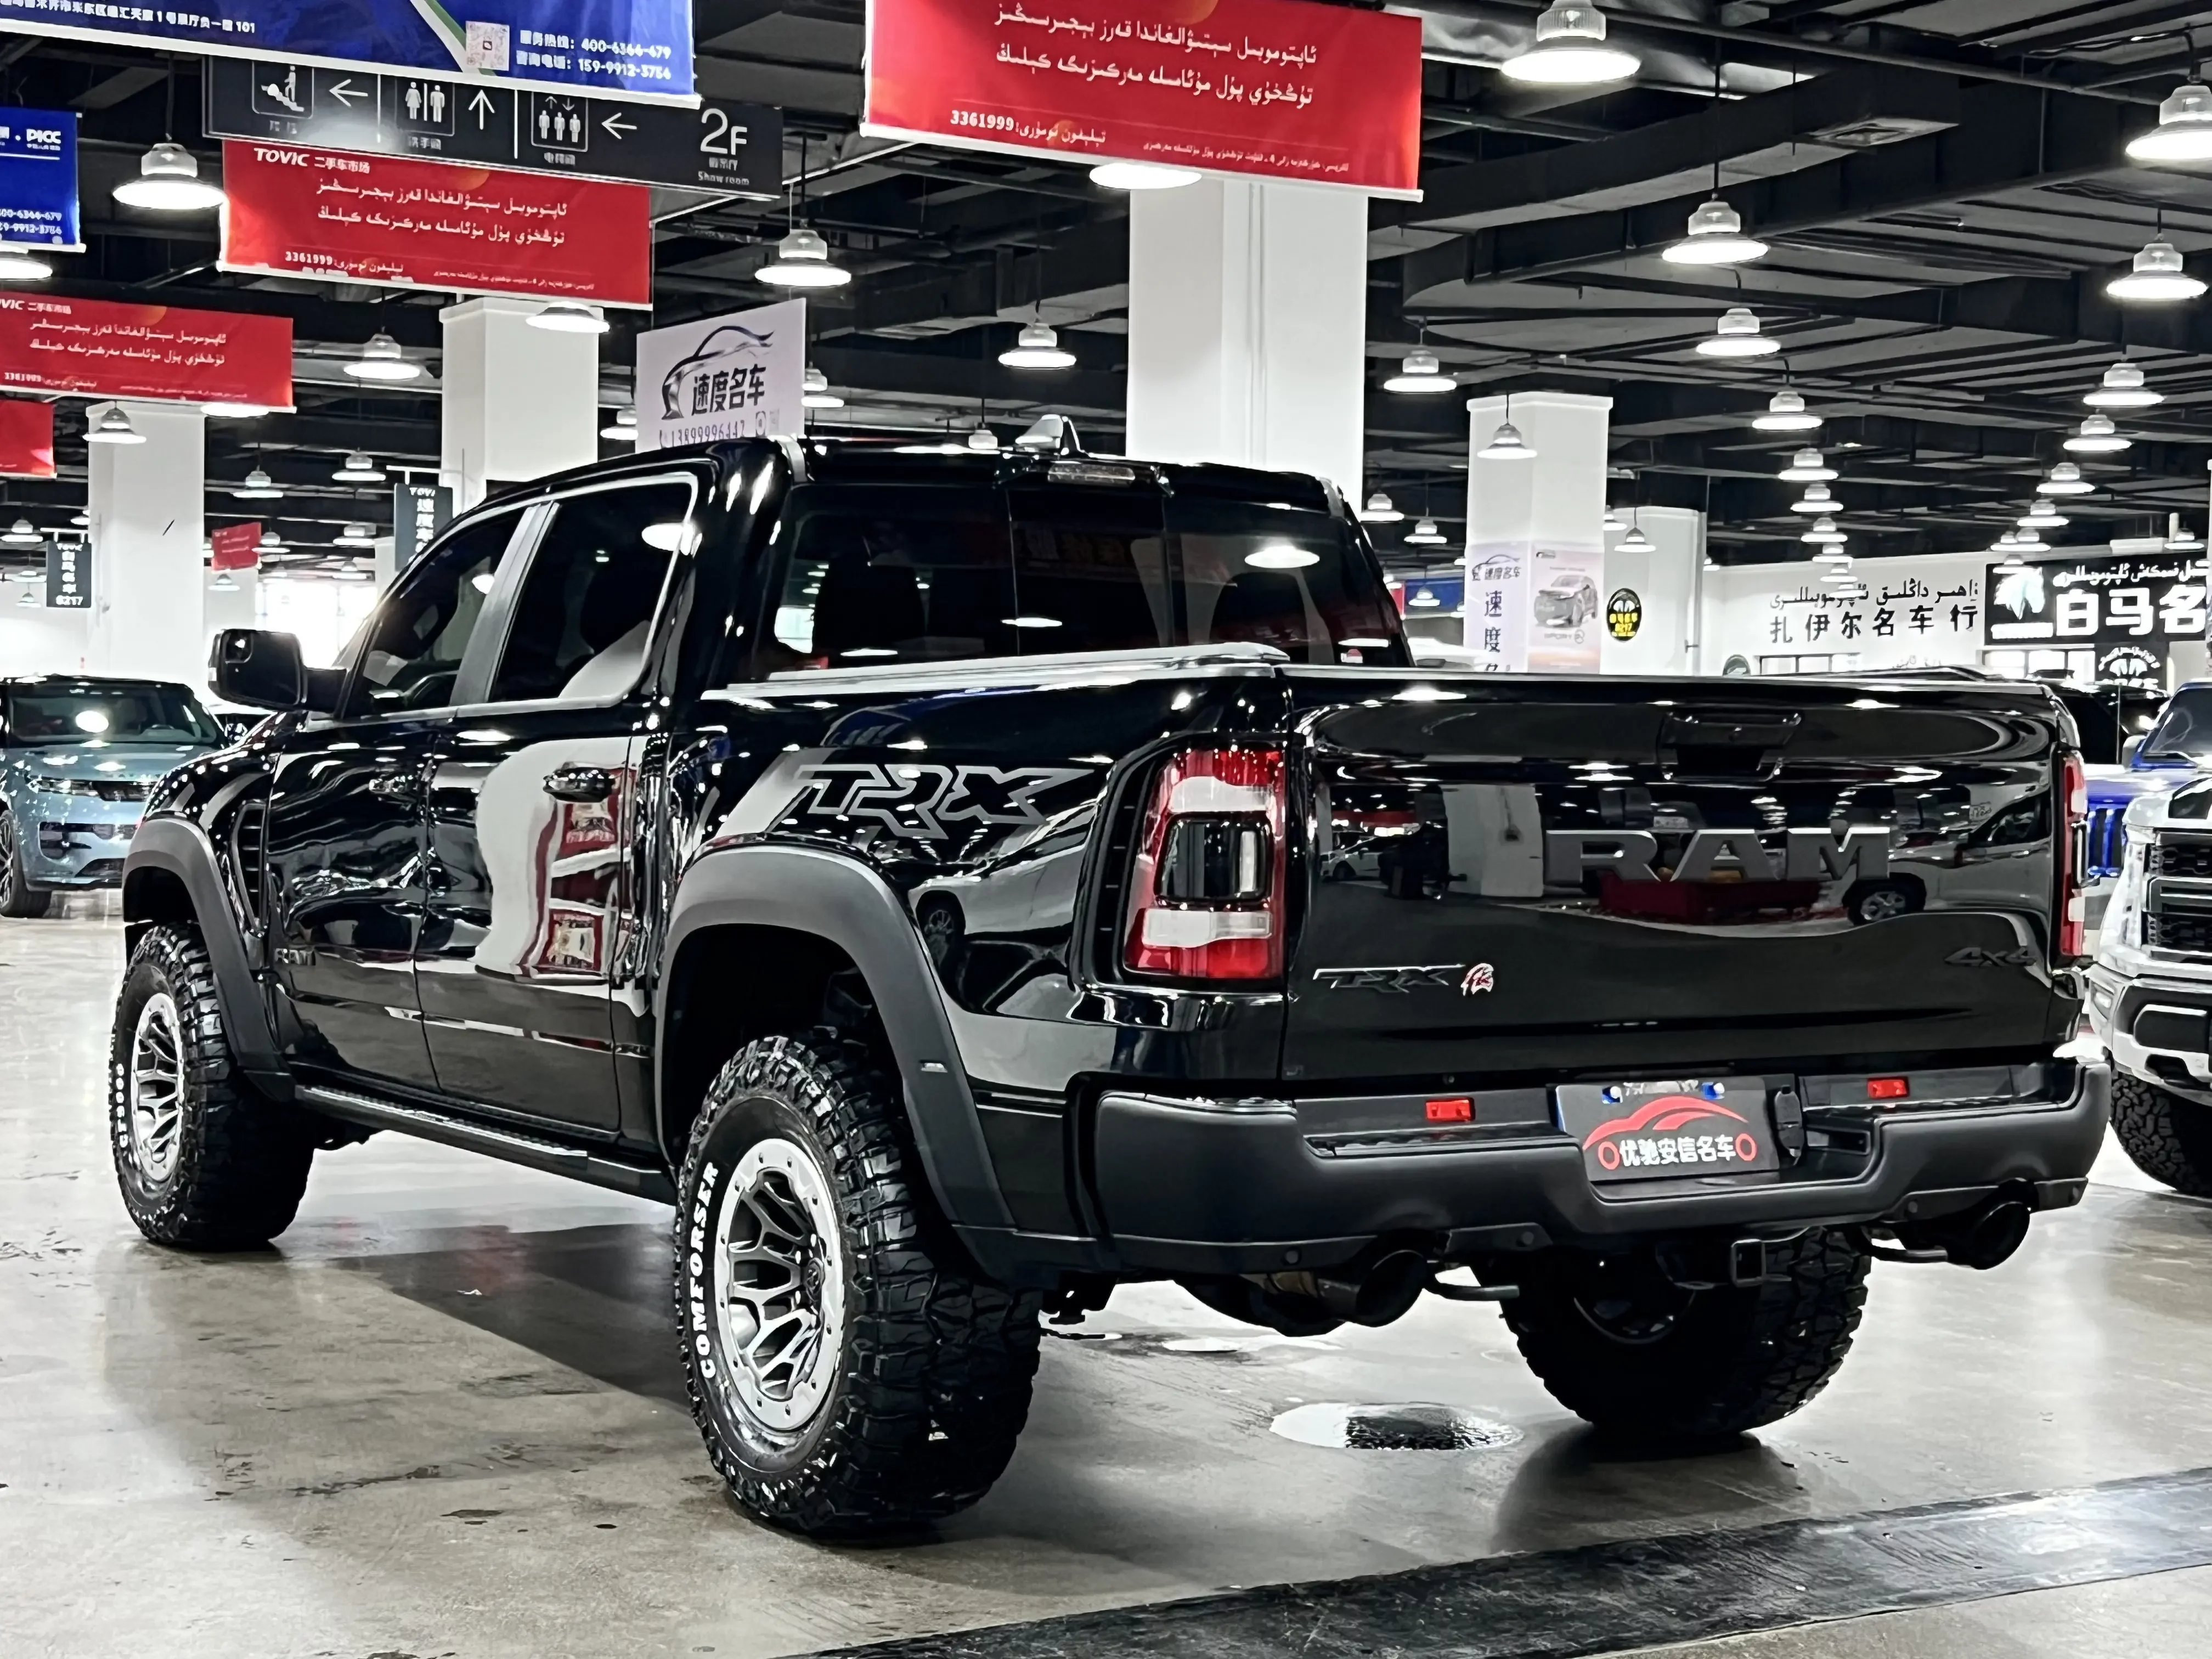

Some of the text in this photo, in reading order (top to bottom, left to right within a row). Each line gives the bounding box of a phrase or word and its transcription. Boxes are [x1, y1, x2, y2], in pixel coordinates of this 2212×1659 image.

[1099, 20, 1131, 41] قەرز
[700, 108, 747, 155] 2F
[950, 110, 1014, 131] 3361999
[253, 147, 308, 167] TOVIC
[691, 363, 767, 416] 速度名车
[1770, 603, 1978, 644] 扎伊尔名车行
[2056, 584, 2207, 636] 白马名
[795, 764, 1095, 840] TRX
[1545, 827, 1891, 883] RAM
[274, 948, 316, 966] RAM
[1312, 963, 1466, 994] TRX
[689, 1161, 719, 1379] COMFORSER
